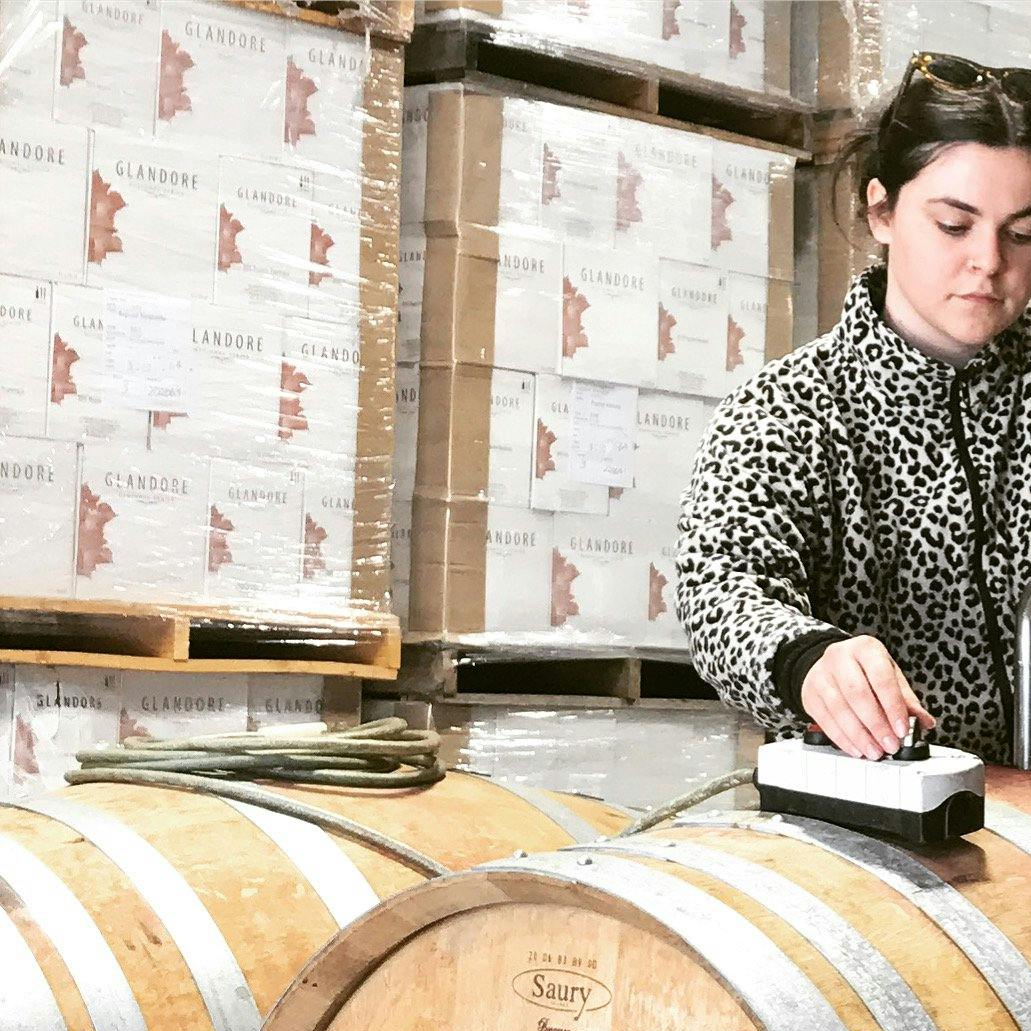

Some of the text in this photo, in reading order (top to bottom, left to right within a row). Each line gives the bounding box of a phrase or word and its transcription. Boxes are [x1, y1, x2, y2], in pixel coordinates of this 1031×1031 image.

[82, 1, 143, 25] GLANDORE
[185, 21, 266, 53] GLANDORE
[115, 160, 199, 190] GLANDORE
[237, 186, 299, 209] GLANDORE
[581, 267, 645, 291] GLANDORE
[671, 286, 718, 305] GLANDORE
[193, 328, 264, 352] LANDORE
[636, 411, 690, 431] LANDORE
[105, 472, 188, 495] GLANDORE
[228, 487, 288, 504] GLANDORE
[570, 537, 634, 555] GLANDORE
[36, 694, 103, 710] GLANDORE
[141, 695, 225, 713] GLANDORE
[532, 973, 593, 1021] Saury
